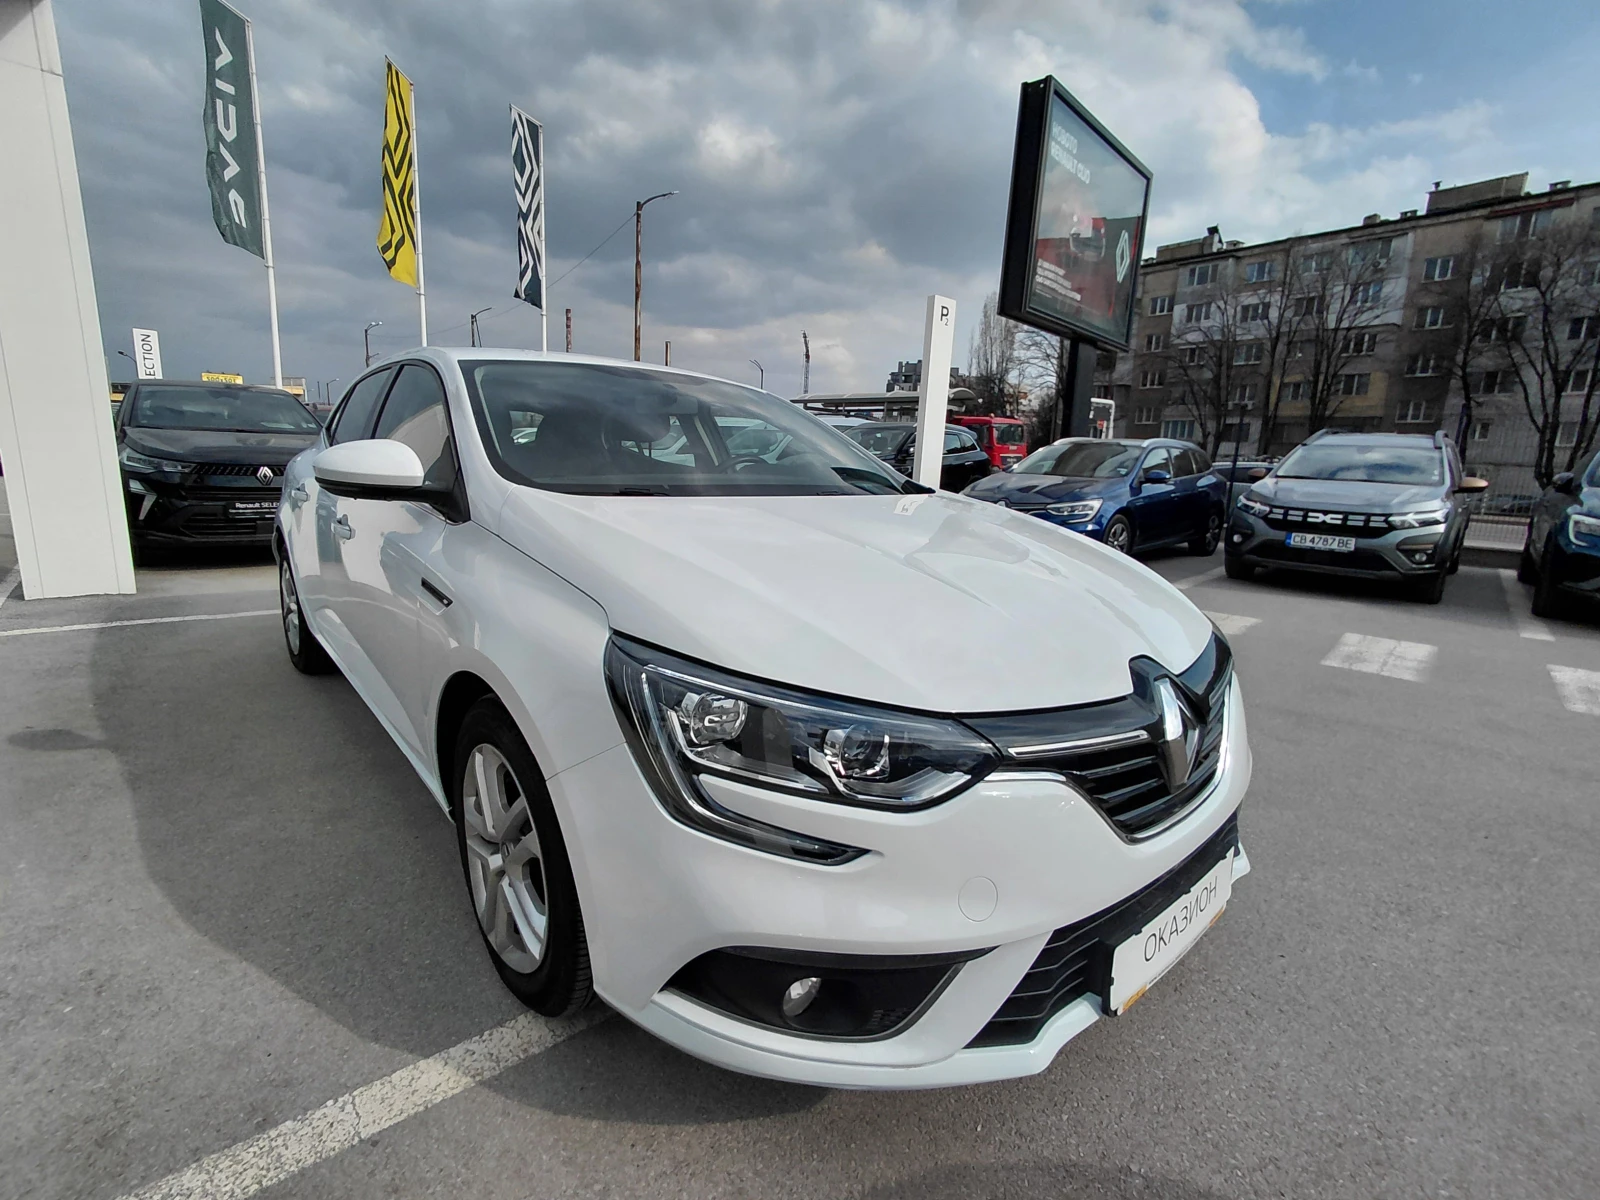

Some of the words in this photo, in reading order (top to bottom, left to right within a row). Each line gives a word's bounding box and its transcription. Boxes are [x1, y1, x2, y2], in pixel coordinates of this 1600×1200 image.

[140, 333, 156, 379] ECTION
[1309, 535, 1336, 547] 4787
[1337, 538, 1354, 549] BE
[1144, 876, 1217, 962] ОКАЗИОН
